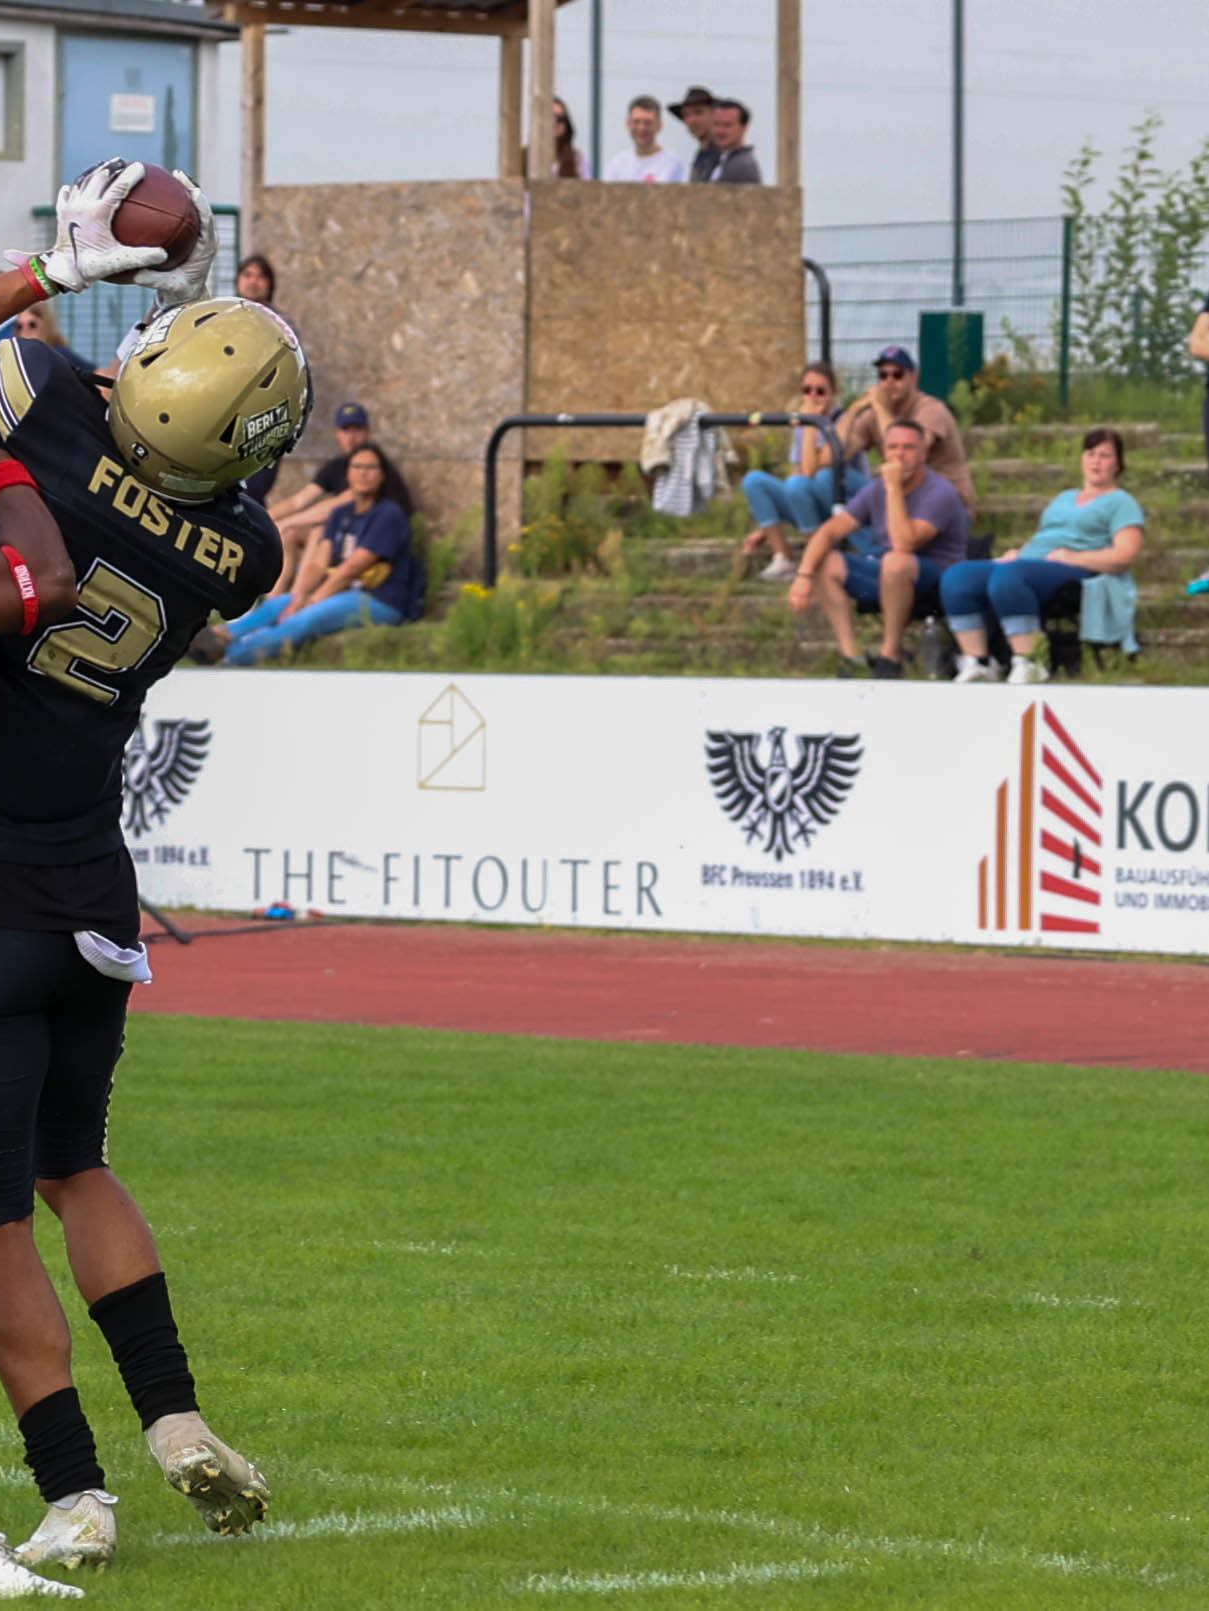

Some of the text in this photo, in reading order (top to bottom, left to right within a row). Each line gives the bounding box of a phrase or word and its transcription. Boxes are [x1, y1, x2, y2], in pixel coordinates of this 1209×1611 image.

[88, 455, 245, 584] FOSTER
[26, 556, 168, 706] 2
[1116, 779, 1209, 853] KO
[243, 847, 663, 917] THE FITOUTER
[701, 864, 727, 887] BFC
[731, 865, 794, 889] Preussen
[799, 869, 835, 890] 1894
[1115, 890, 1149, 908] UND
